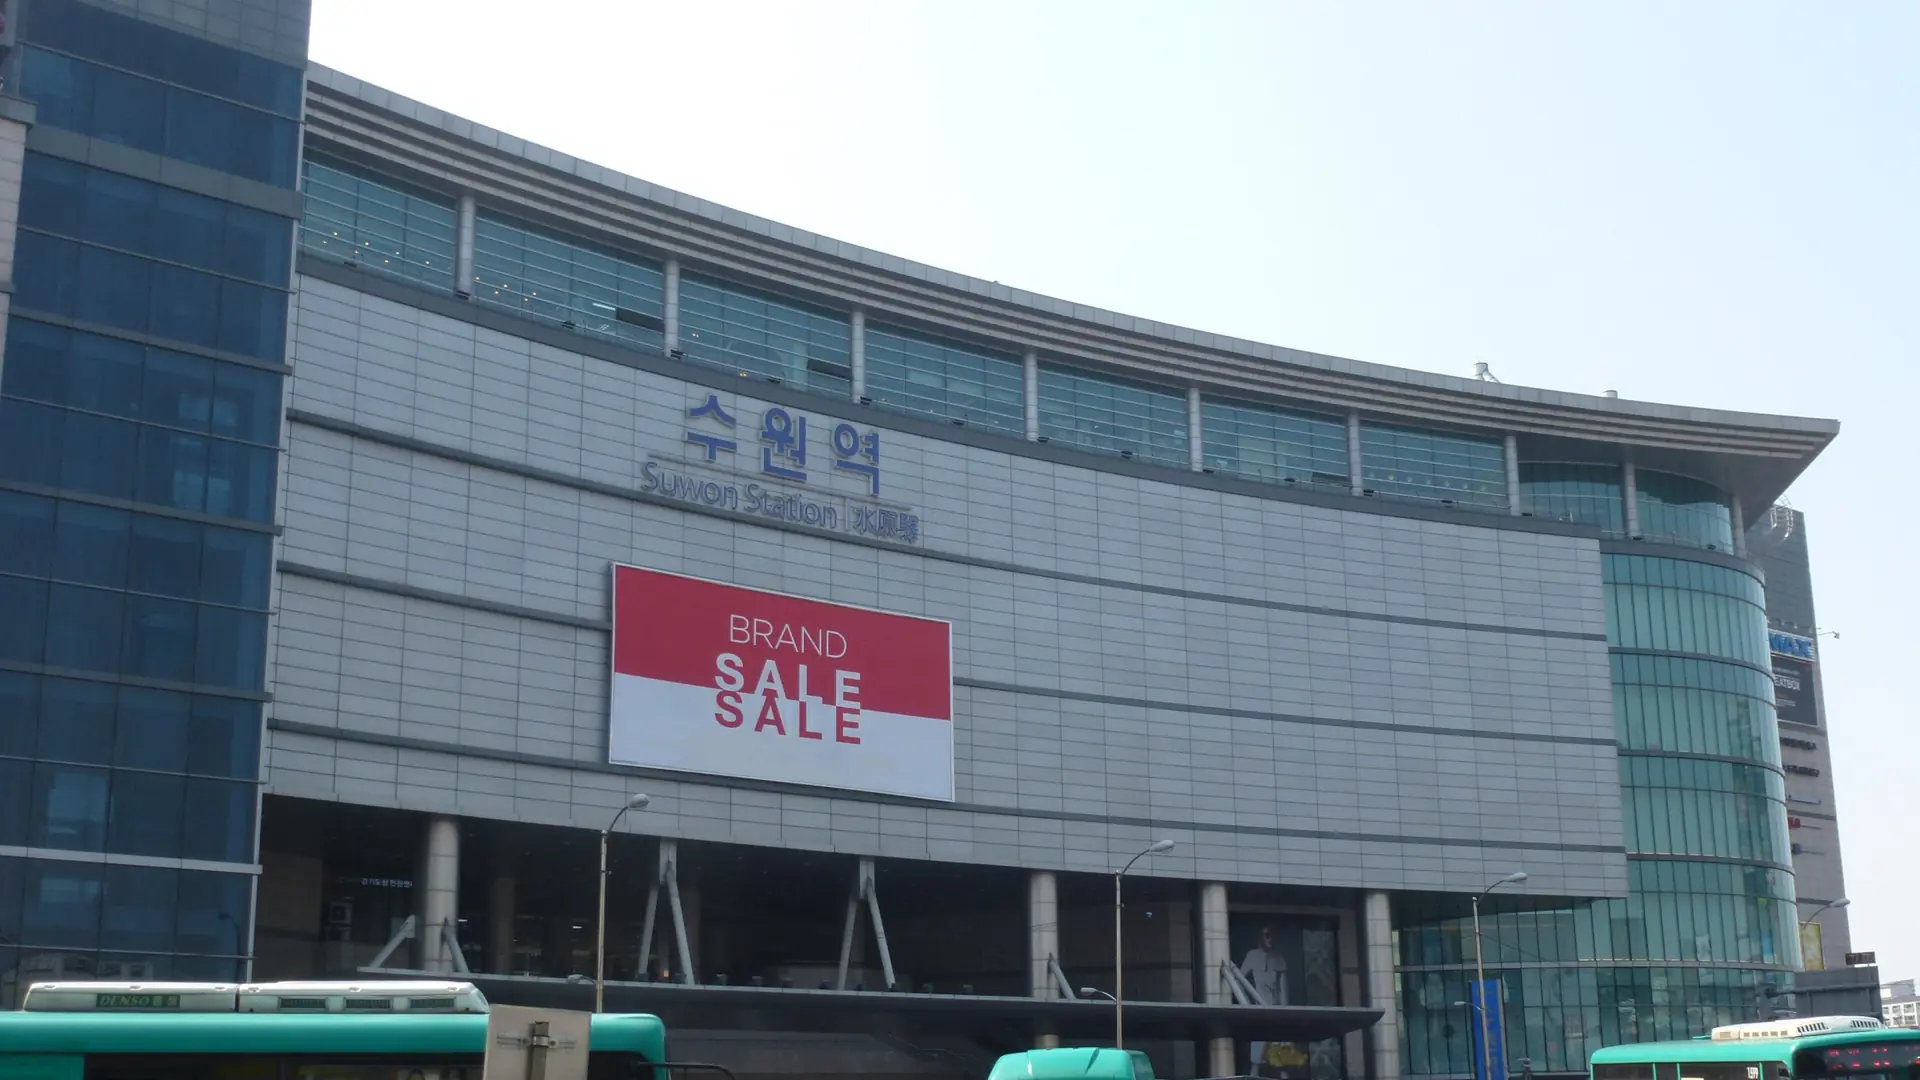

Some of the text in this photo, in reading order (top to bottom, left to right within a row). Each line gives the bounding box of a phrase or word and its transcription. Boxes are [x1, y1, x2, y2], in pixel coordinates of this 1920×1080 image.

[685, 394, 880, 496] 수원역
[641, 462, 739, 511] Suwon
[743, 482, 838, 530] Station
[729, 613, 848, 659] BRAND
[714, 652, 862, 710] SALE
[714, 690, 862, 745] SALE
[99, 995, 150, 1006] DENSO
